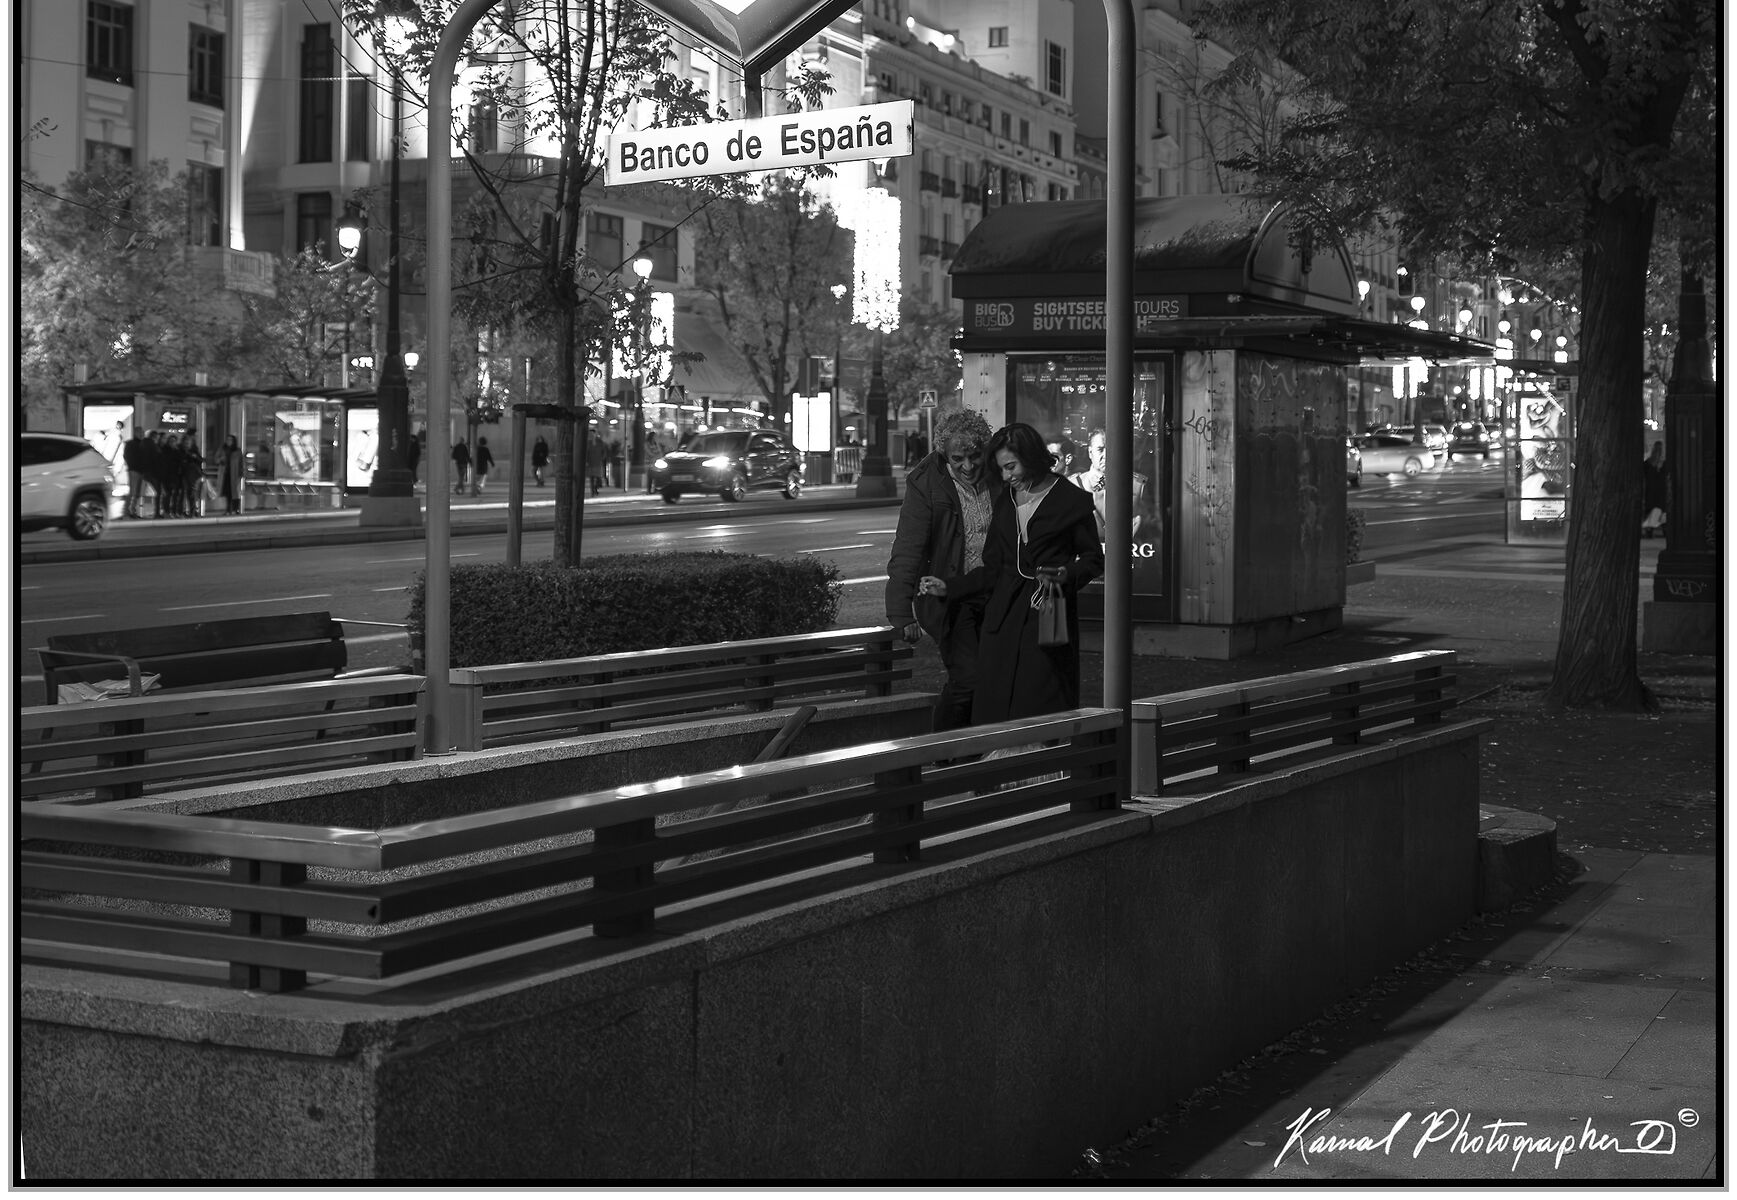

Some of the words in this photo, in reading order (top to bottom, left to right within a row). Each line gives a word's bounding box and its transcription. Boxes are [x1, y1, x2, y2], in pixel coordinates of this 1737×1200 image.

[619, 141, 709, 174] Banco
[726, 129, 763, 162] de
[780, 114, 893, 160] España
[975, 303, 998, 316] BIG
[1033, 301, 1107, 316] SIGHTSEE
[1133, 300, 1180, 314] TOURS
[975, 316, 997, 328] BUS
[1032, 316, 1065, 331] BUY
